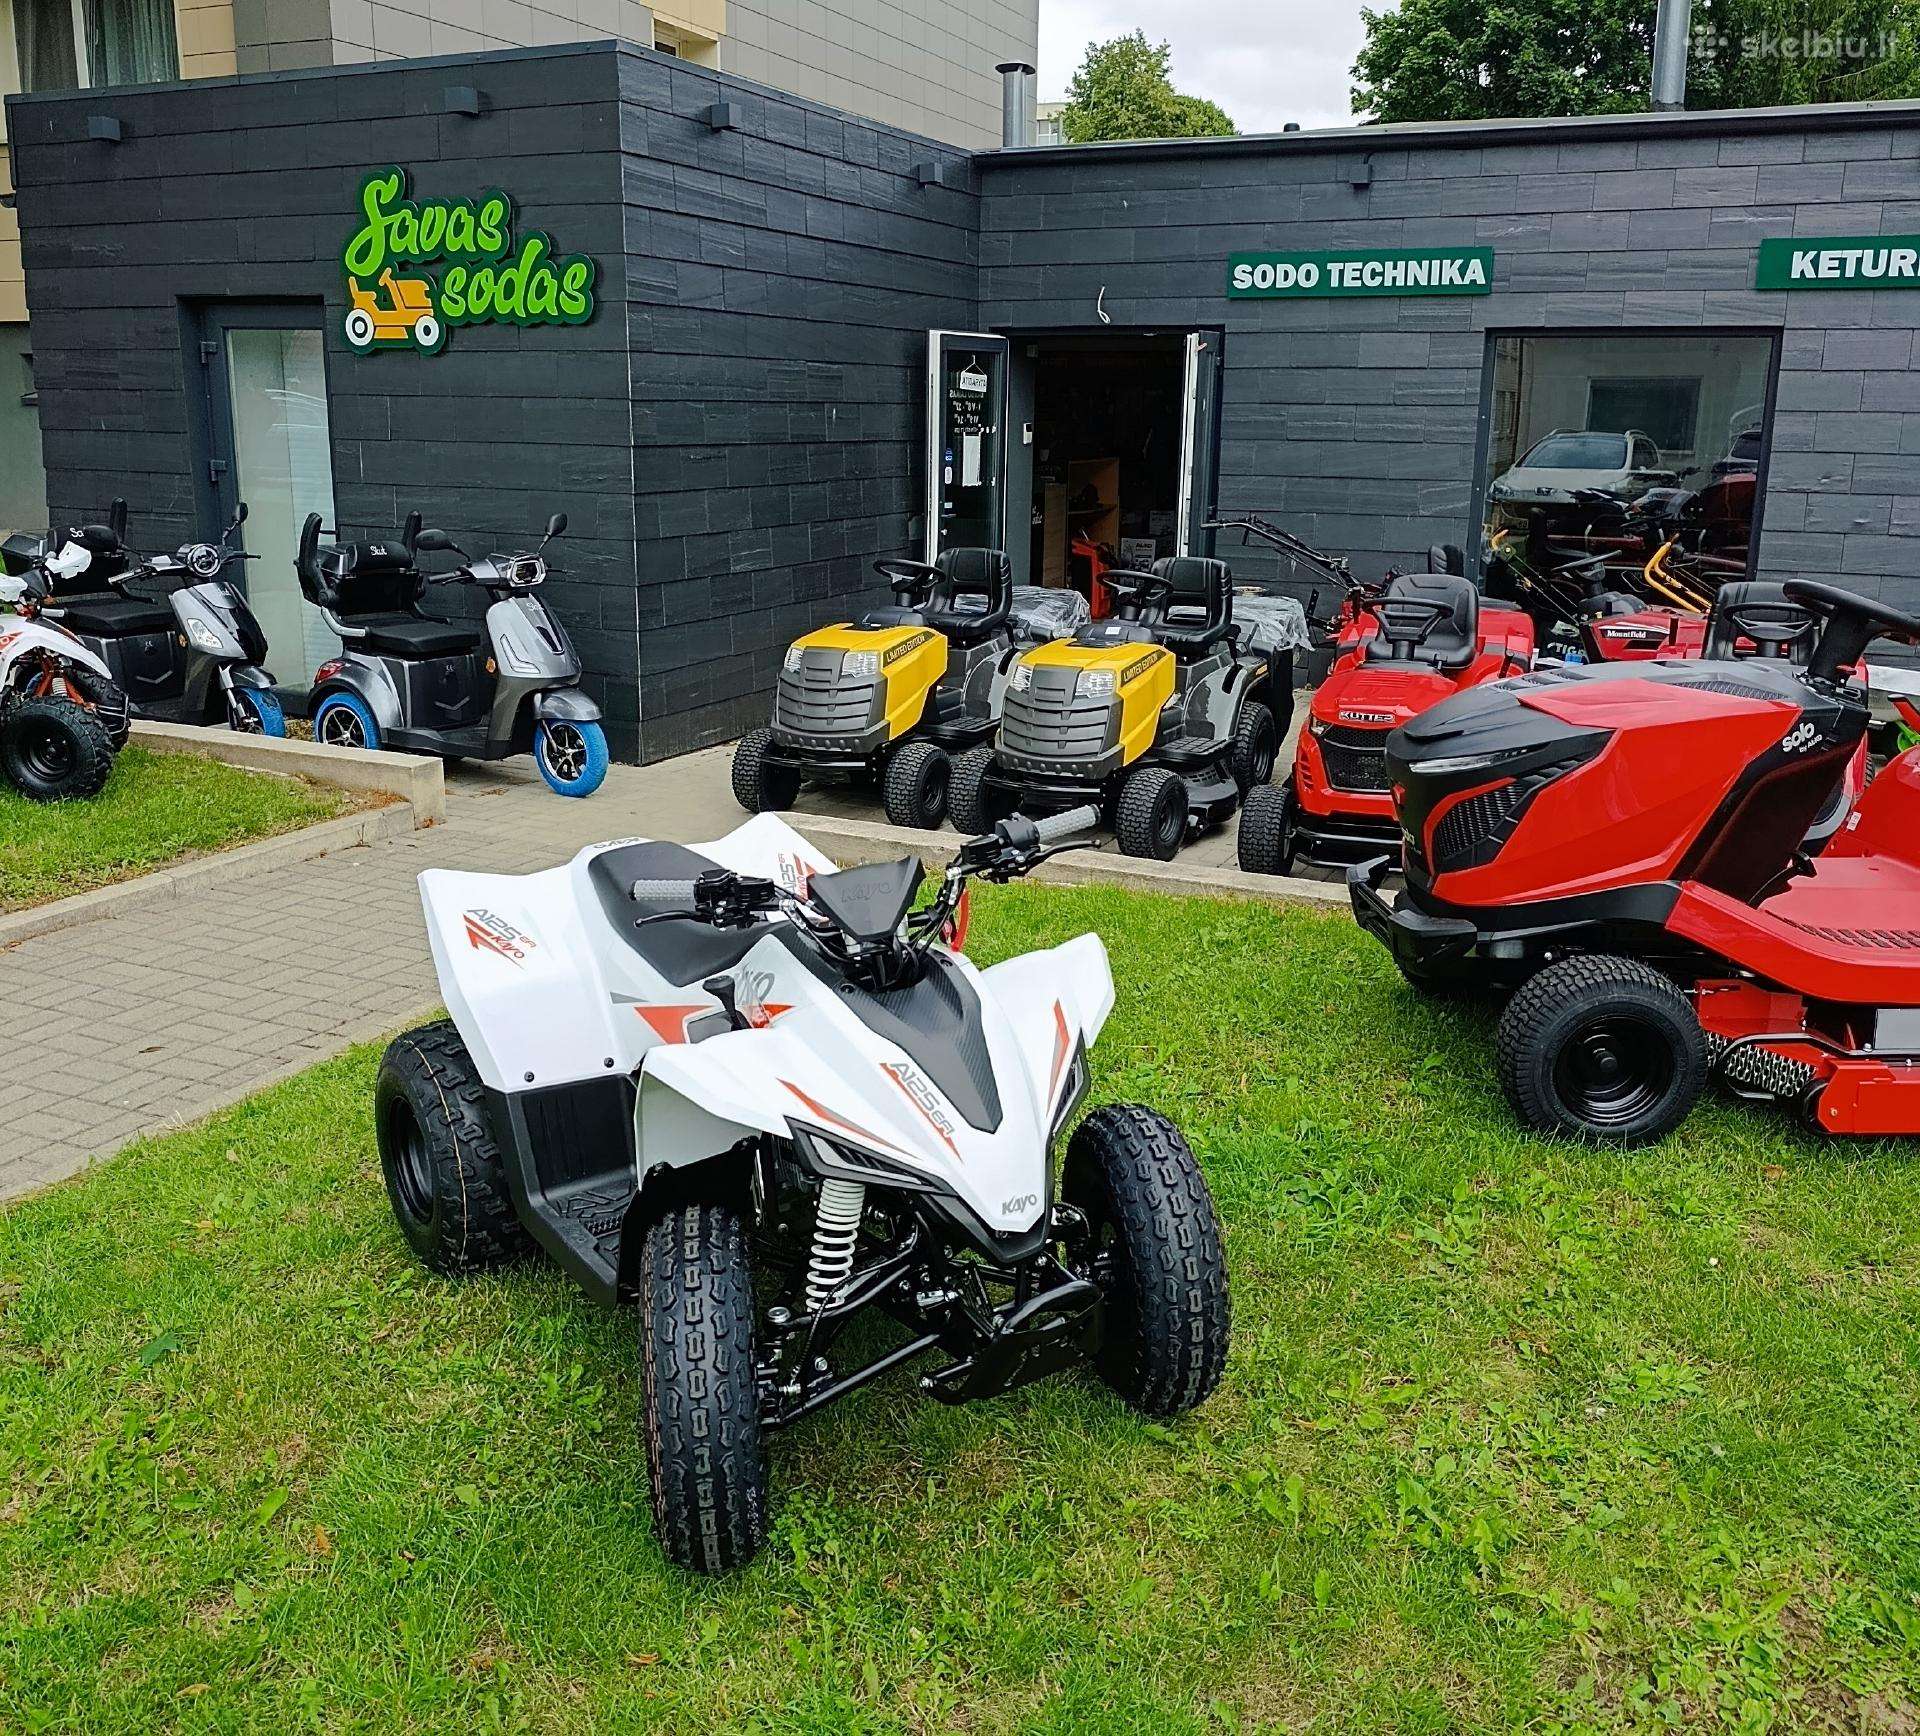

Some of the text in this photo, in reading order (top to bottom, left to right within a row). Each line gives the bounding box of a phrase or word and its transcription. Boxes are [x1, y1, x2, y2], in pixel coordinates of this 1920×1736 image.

[345, 174, 504, 277] Savas
[441, 239, 588, 318] sodas
[1232, 258, 1486, 289] SODO TECHNIKA
[1790, 248, 1920, 279] KETUR
[886, 635, 925, 662] LIMITED EDITION
[1606, 629, 1647, 639] Mountfield
[1123, 653, 1159, 682] LIMITED EDITION
[1340, 711, 1394, 722] KUTTER
[1782, 722, 1815, 752] solo
[466, 908, 522, 941] A125
[890, 1062, 955, 1135] A125 EFI
[1002, 1194, 1037, 1215] KAYO
